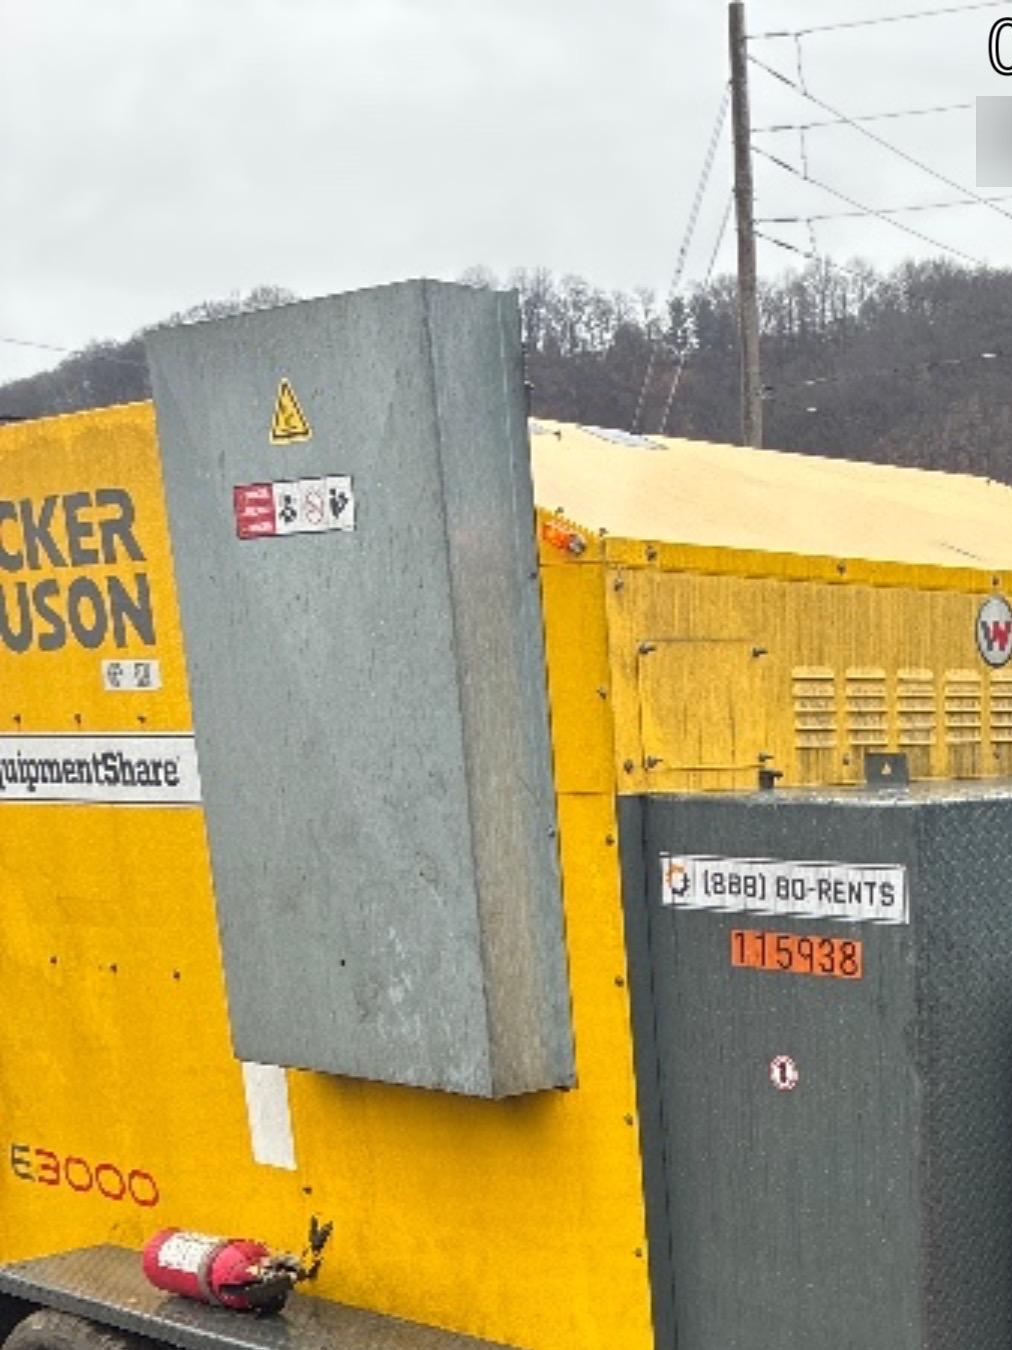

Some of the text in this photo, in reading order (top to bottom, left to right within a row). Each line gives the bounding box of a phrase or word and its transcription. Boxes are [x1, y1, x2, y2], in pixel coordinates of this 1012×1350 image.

[0, 572, 157, 654] USON
[703, 869, 896, 907] (888) 80-RENTS
[733, 931, 858, 977] 115938
[11, 1142, 160, 1208] E3000
